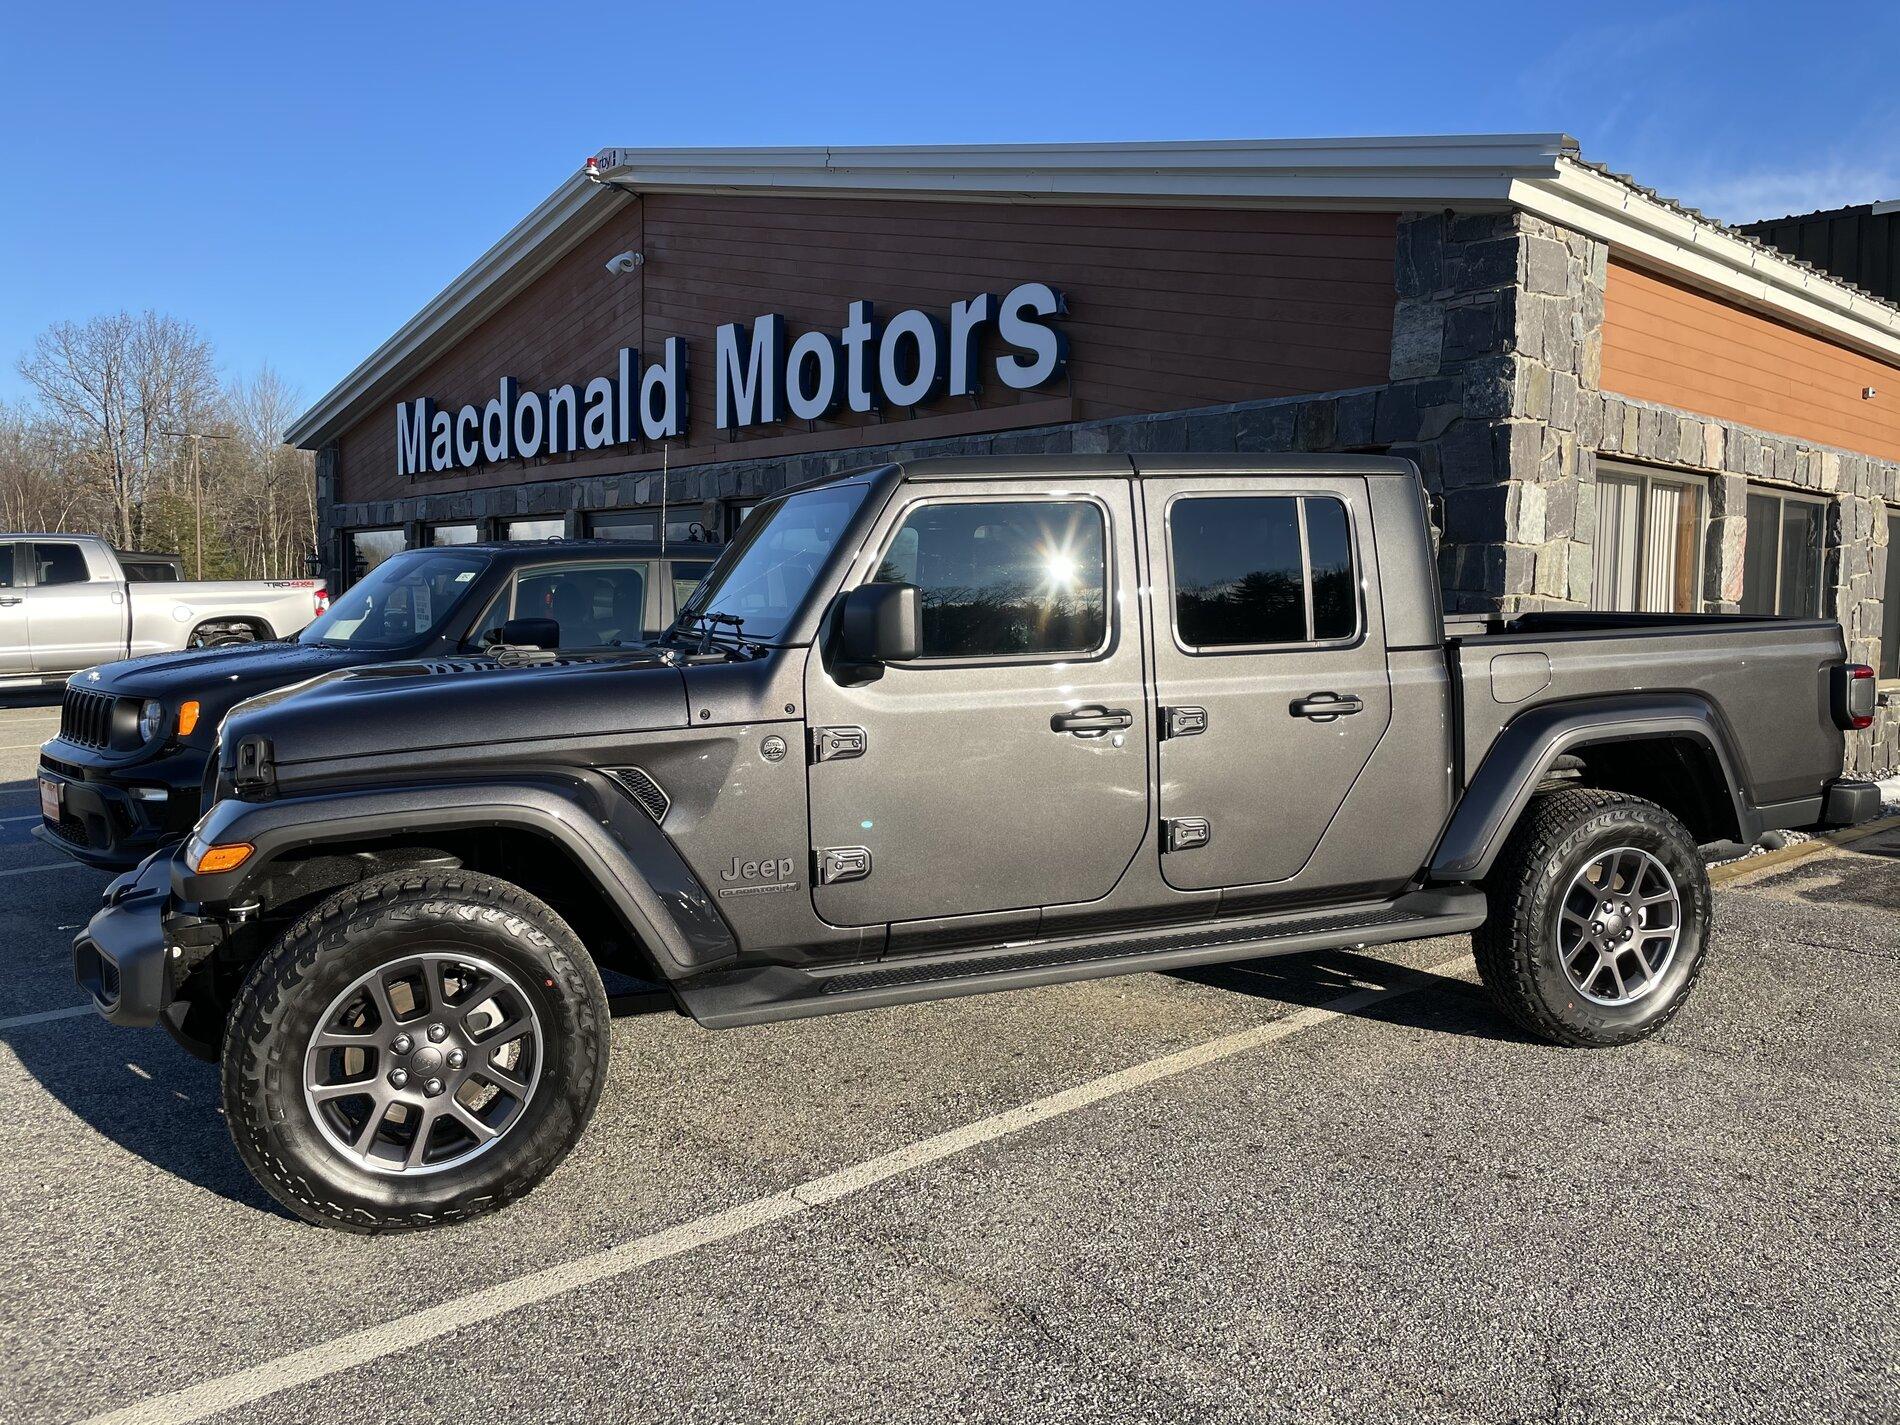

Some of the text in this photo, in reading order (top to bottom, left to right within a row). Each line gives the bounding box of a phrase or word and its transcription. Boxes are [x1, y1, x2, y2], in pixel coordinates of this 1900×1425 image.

[396, 282, 1061, 476] Macdonald Motors
[720, 857, 795, 881] Jeep
